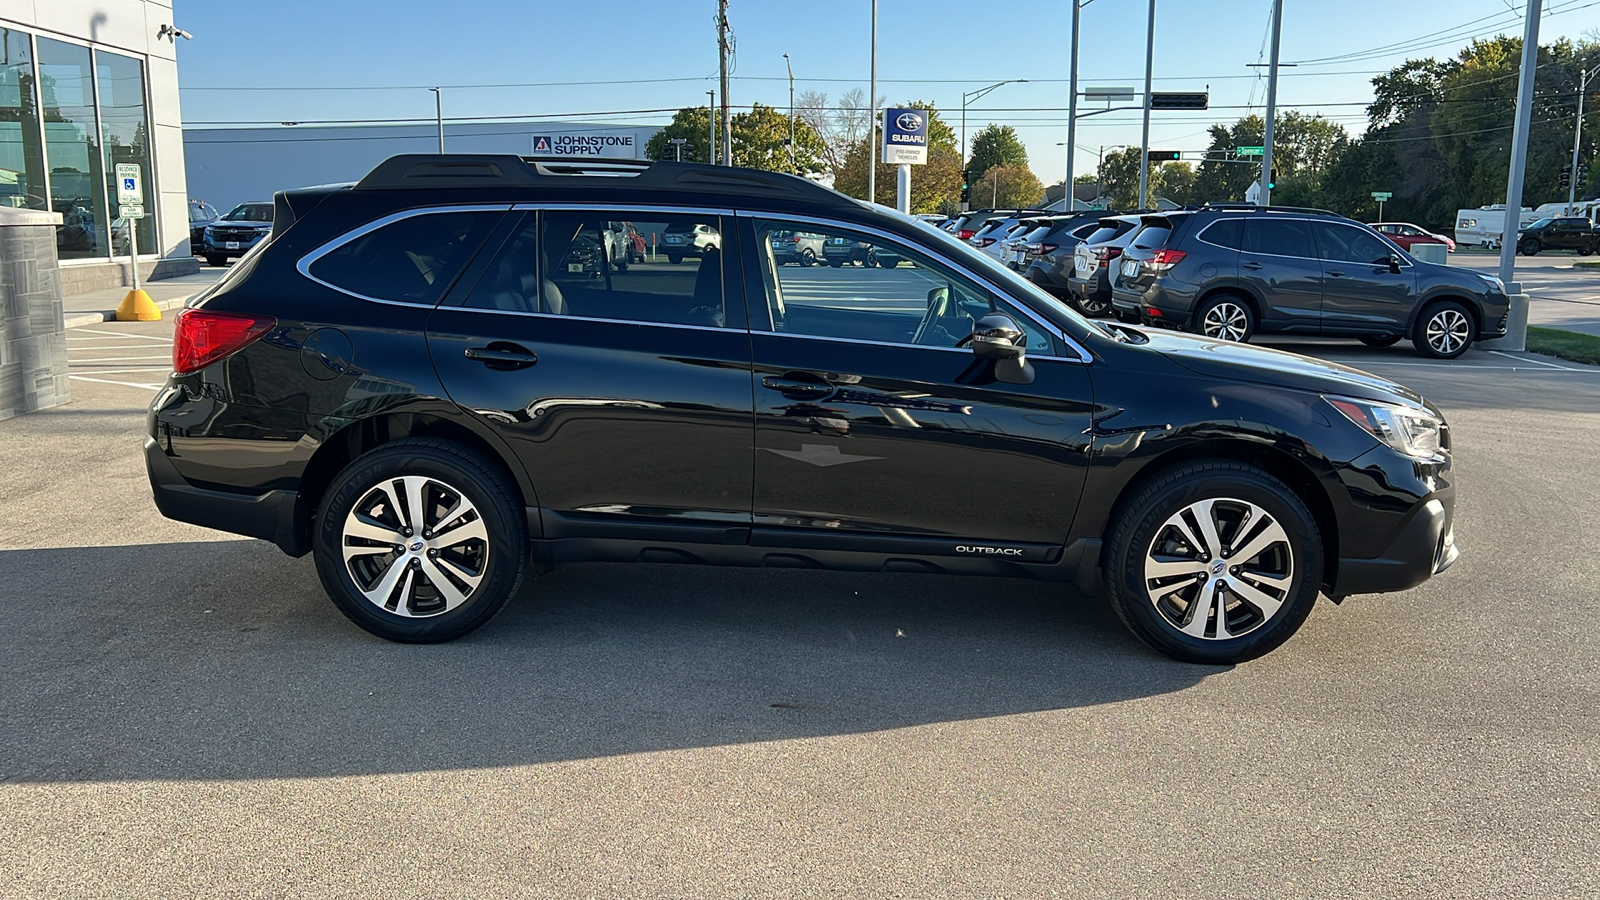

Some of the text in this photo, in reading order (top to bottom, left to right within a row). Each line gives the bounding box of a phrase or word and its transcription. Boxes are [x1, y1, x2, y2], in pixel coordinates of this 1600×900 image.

[554, 136, 632, 146] JOHNSTONE
[892, 134, 924, 143] SUBARU
[554, 146, 603, 154] SUPPLY
[1241, 147, 1260, 155] Spencer
[955, 545, 1023, 556] OUTBACK
